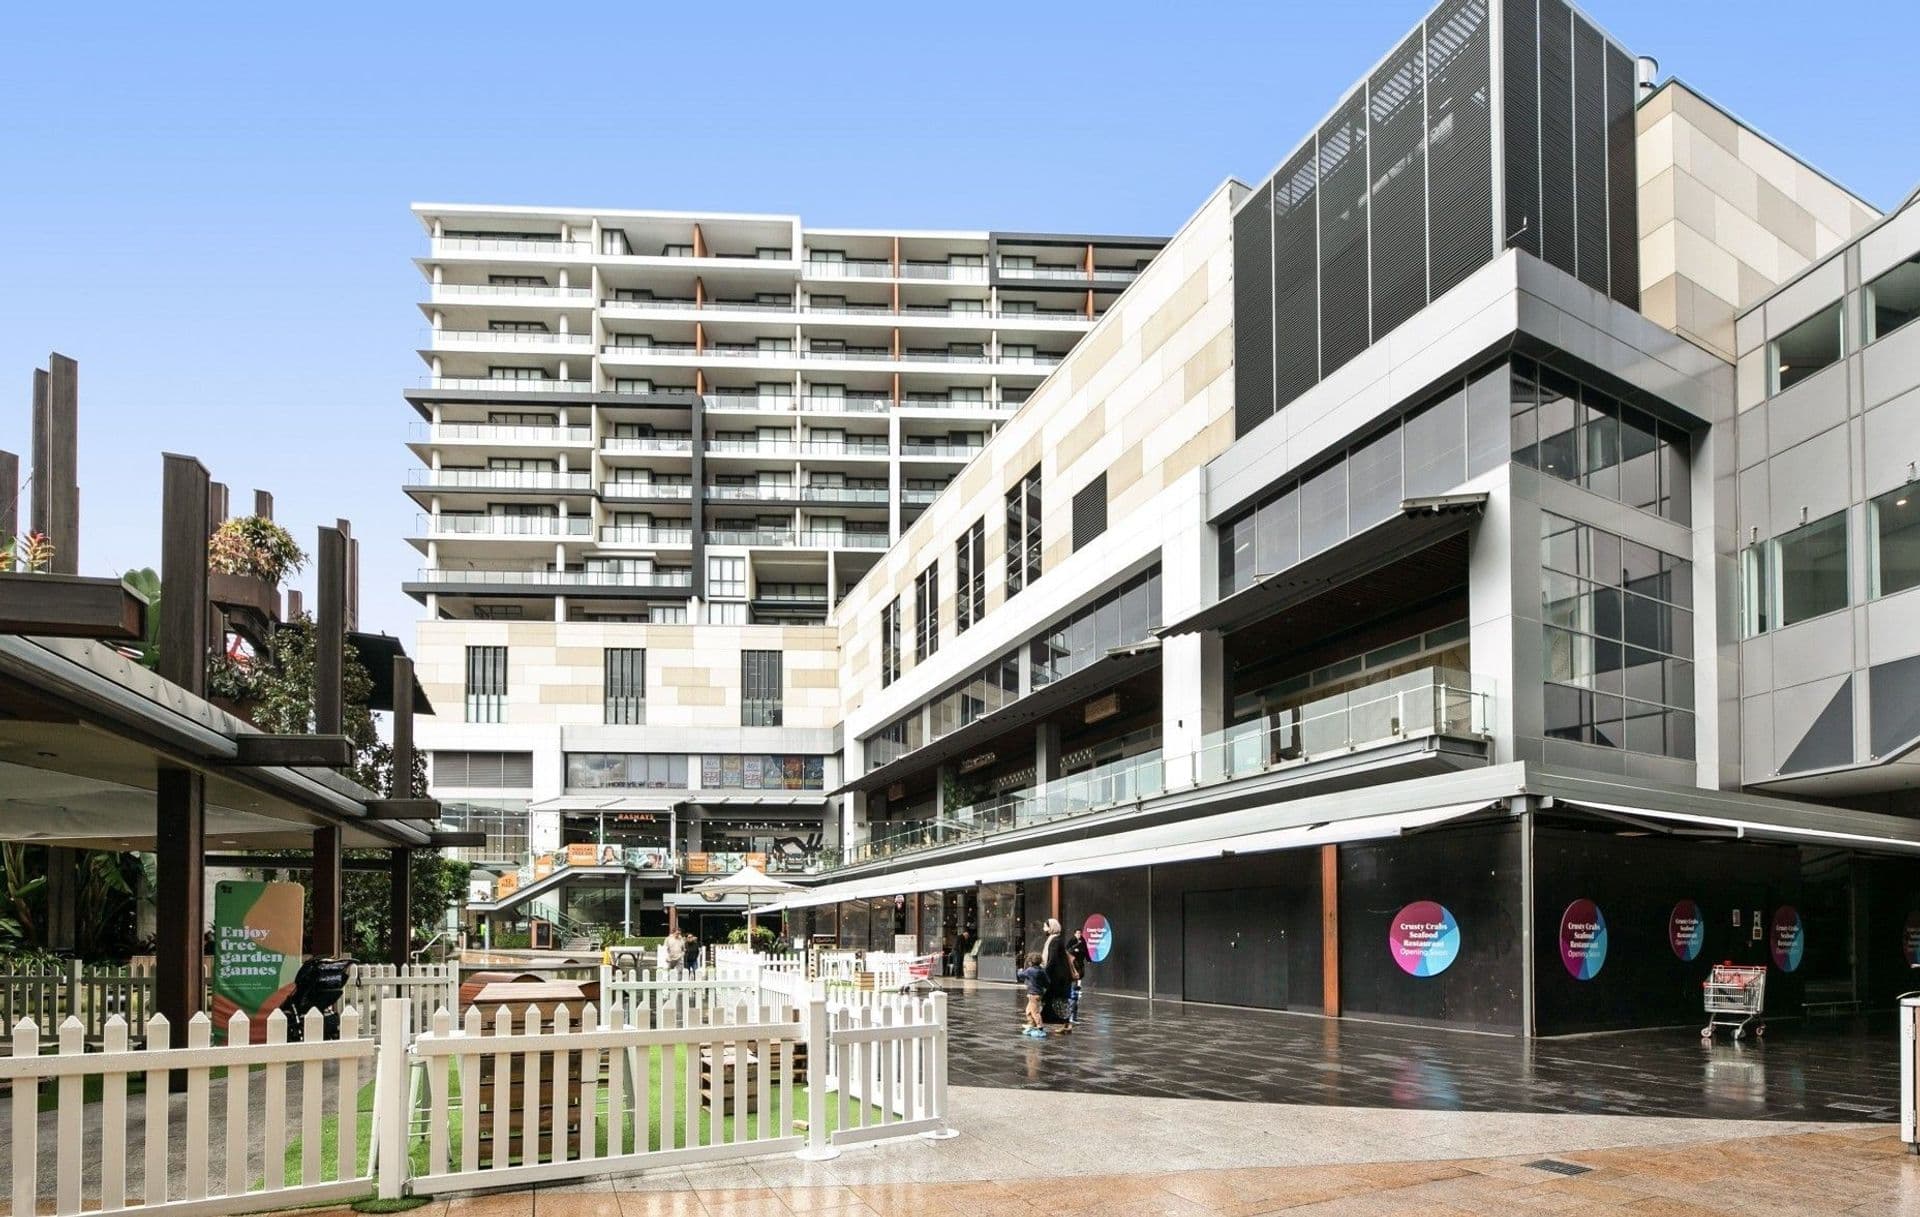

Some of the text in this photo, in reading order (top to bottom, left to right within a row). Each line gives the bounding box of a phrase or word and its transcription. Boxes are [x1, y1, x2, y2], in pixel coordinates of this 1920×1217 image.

[1400, 922, 1448, 931] Crusty Crabs
[1568, 922, 1600, 931] Crusty Crabs
[221, 926, 270, 941] Enjoy
[221, 939, 256, 950] free
[1400, 949, 1428, 957] Opening
[1568, 950, 1588, 959] Opening
[220, 951, 283, 966] garden
[220, 965, 277, 978] games
